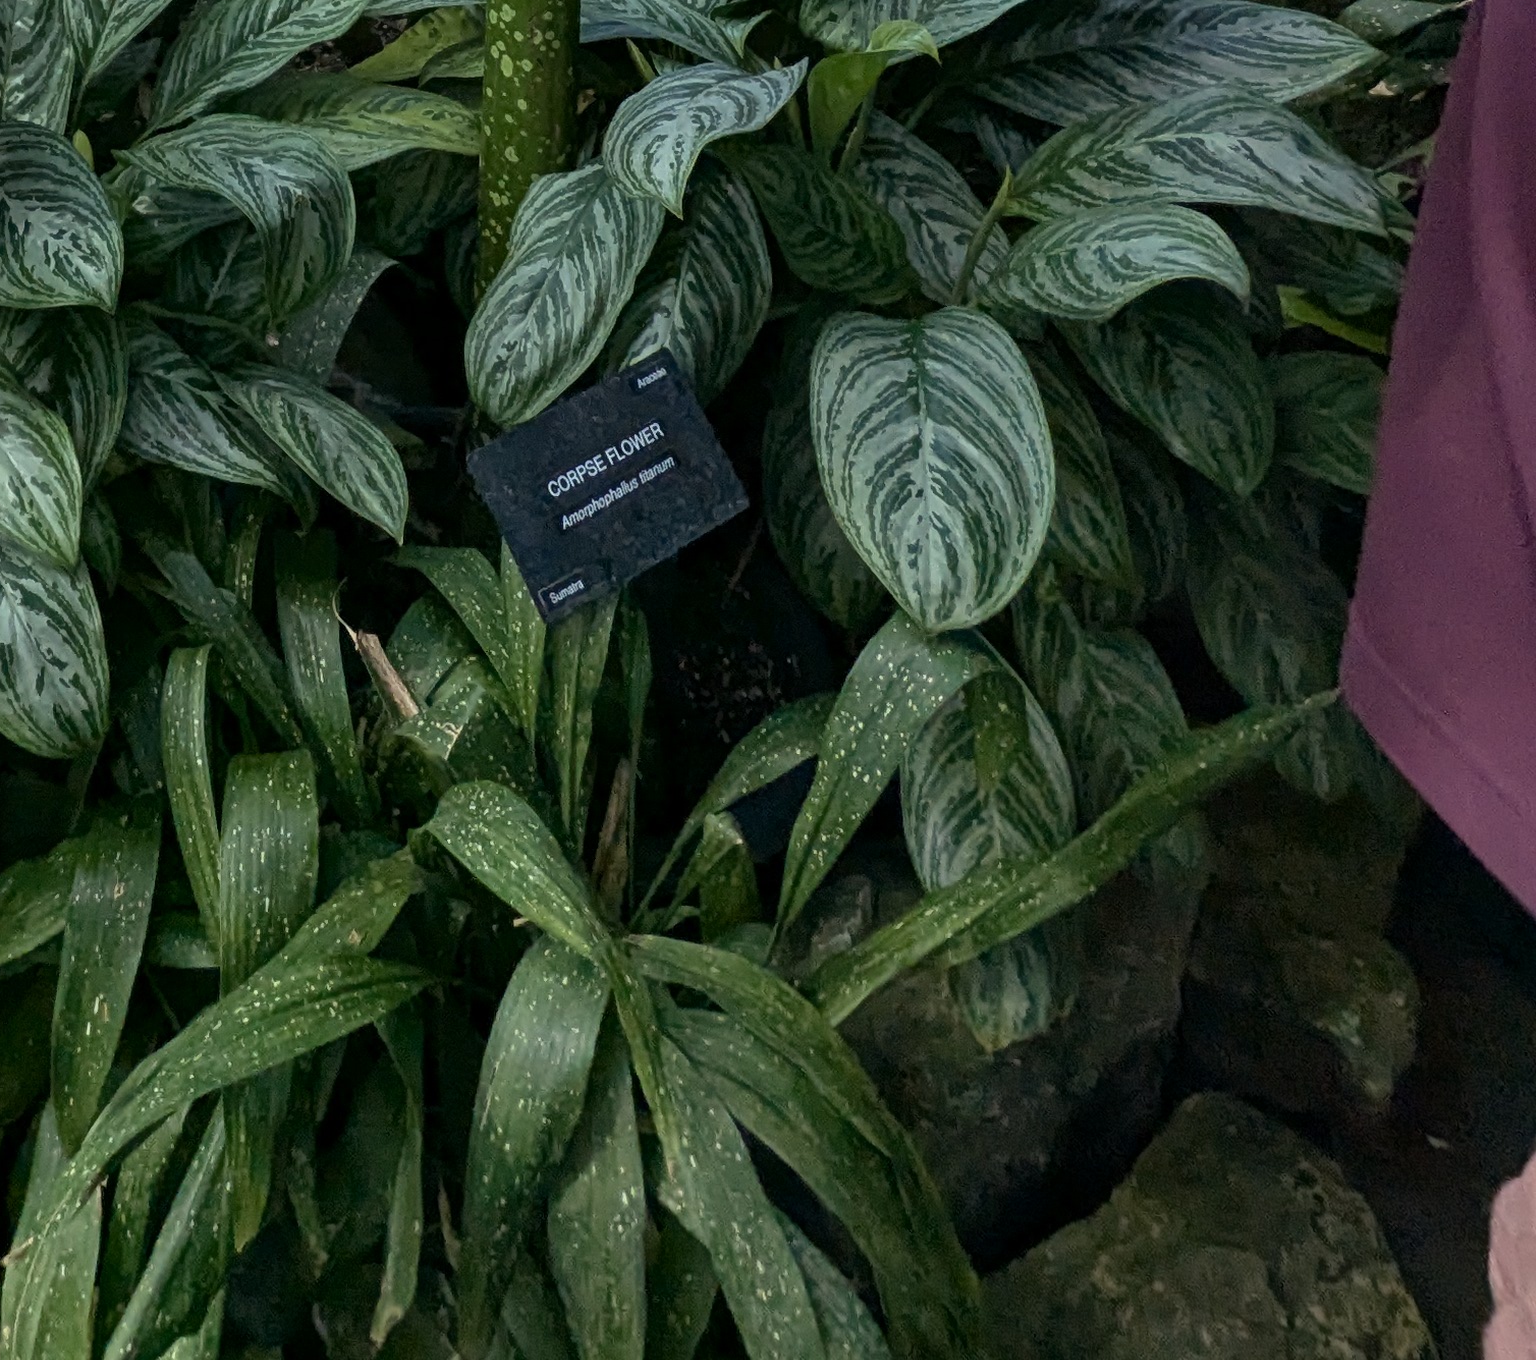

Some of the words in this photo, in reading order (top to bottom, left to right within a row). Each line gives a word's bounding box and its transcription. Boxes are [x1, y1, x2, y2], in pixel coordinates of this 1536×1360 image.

[548, 454, 606, 497] CORPSE
[605, 423, 665, 466] FLOWER
[562, 479, 638, 530] Amorphophallus
[639, 455, 674, 484] titanum
[550, 580, 584, 604] Sumatra
